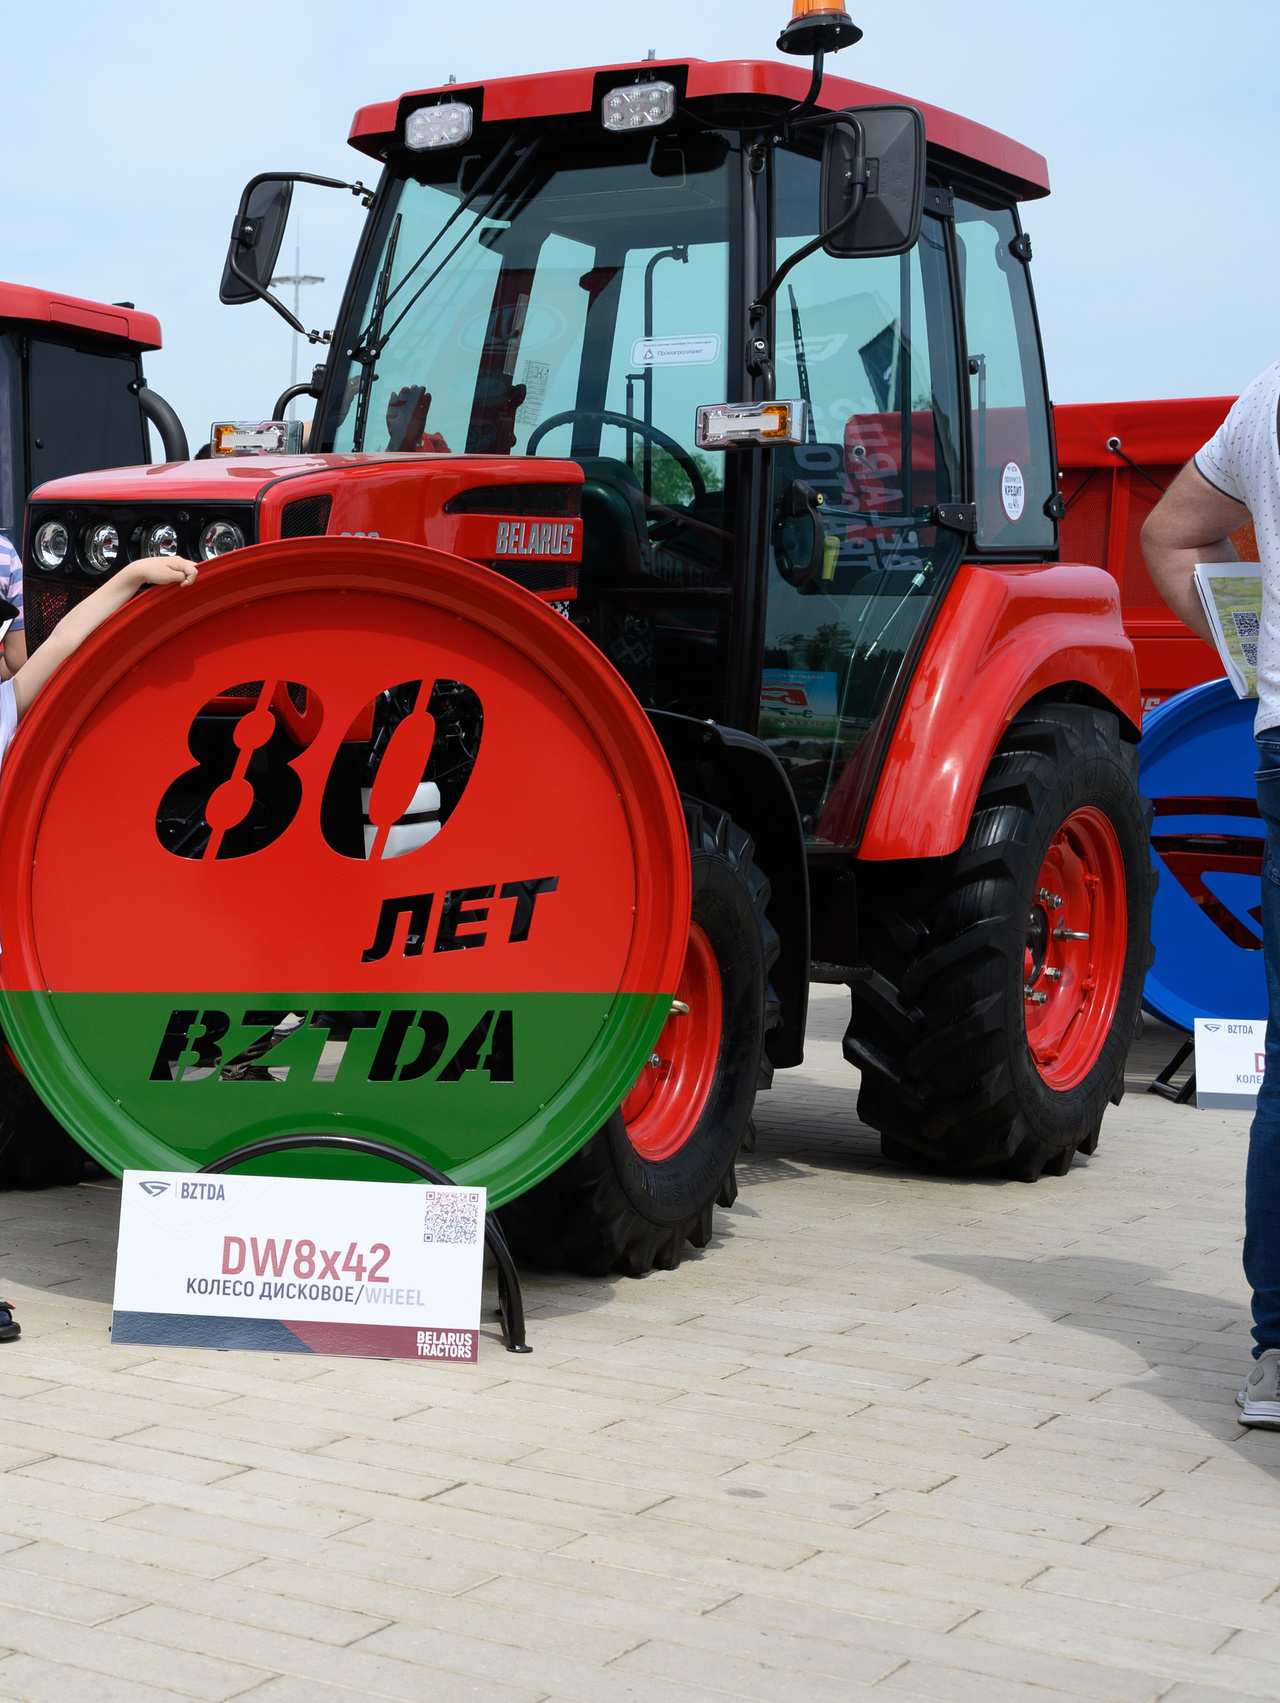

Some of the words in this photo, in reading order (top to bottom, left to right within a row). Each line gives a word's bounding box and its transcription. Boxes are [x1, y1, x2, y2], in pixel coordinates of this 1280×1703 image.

[1005, 485, 1022, 497] КРЕДИТ
[495, 521, 574, 555] BELARUS
[154, 678, 485, 861] 80
[361, 875, 560, 964] ЛЕТ
[1227, 1024, 1254, 1035] BZTDA
[149, 1009, 514, 1083] BZTDA
[1254, 1052, 1266, 1073] D
[1236, 1074, 1264, 1084] КОЛЕ
[180, 1182, 226, 1202] BZTDA
[221, 1234, 391, 1284] DW8x42
[186, 1277, 255, 1298] КОЛЕСО
[259, 1279, 425, 1307] ДИСКОВОЕ/WHEEL
[417, 1330, 473, 1346] BELARUS
[416, 1343, 472, 1359] TRACTORS
